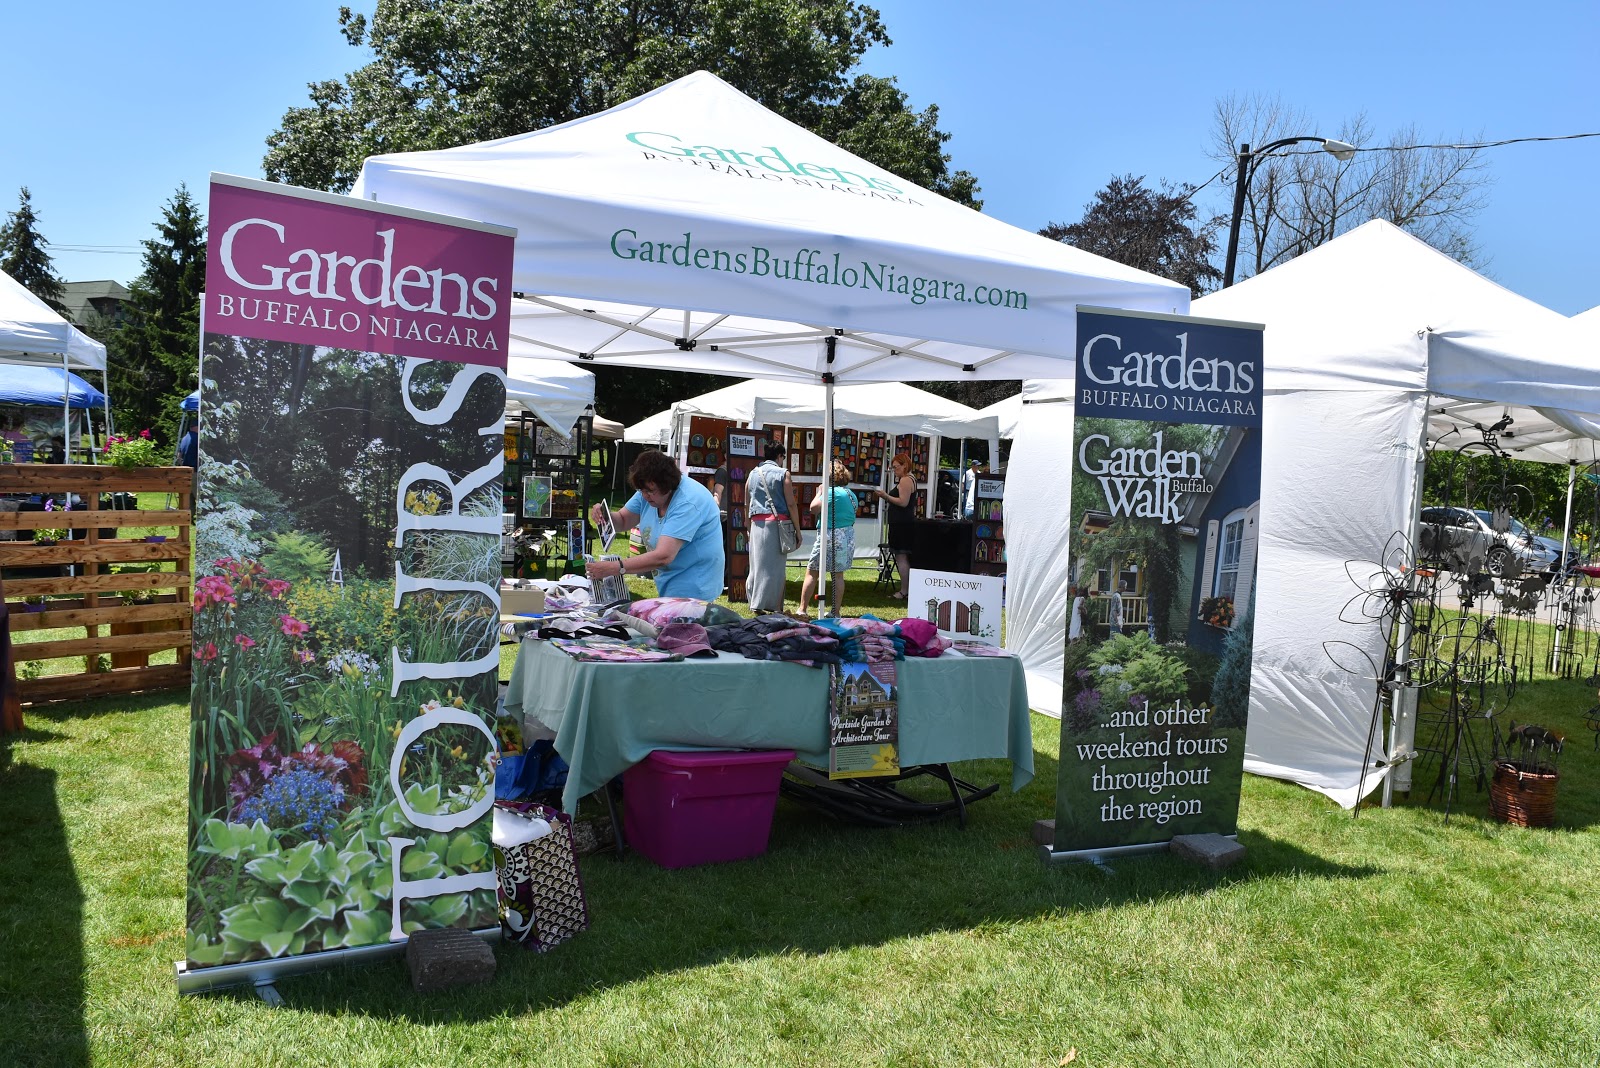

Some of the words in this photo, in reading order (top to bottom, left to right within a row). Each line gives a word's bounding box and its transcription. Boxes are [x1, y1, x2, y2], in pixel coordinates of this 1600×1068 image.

[626, 131, 904, 195] Gardens
[790, 177, 924, 207] NIAGARA
[219, 218, 499, 321] Gardens
[610, 228, 1028, 311] GardensBuffaloNiagara.com
[217, 294, 361, 333] BUFFALO
[369, 315, 499, 351] NIAGARA
[1082, 332, 1254, 394] Gardens
[1081, 389, 1168, 410] BUFFALO
[1172, 395, 1257, 416] NIAGARA
[732, 436, 753, 446] Starter
[1078, 430, 1204, 479] Garden
[1097, 475, 1185, 525] Walk
[1172, 478, 1214, 493] Buffalo
[924, 577, 952, 588] OPEN
[954, 580, 982, 591] NOW!
[388, 357, 507, 941] TOURS
[831, 717, 860, 731] Parkside
[861, 714, 885, 734] Garden
[885, 714, 892, 726] &
[1153, 699, 1210, 726] other
[831, 731, 873, 746] Architecture
[873, 728, 891, 743] Tour
[1076, 730, 1171, 761] weekend
[1176, 736, 1228, 756] tours
[1092, 761, 1211, 795] throughout
[1100, 795, 1134, 822] the
[1137, 795, 1202, 825] region
